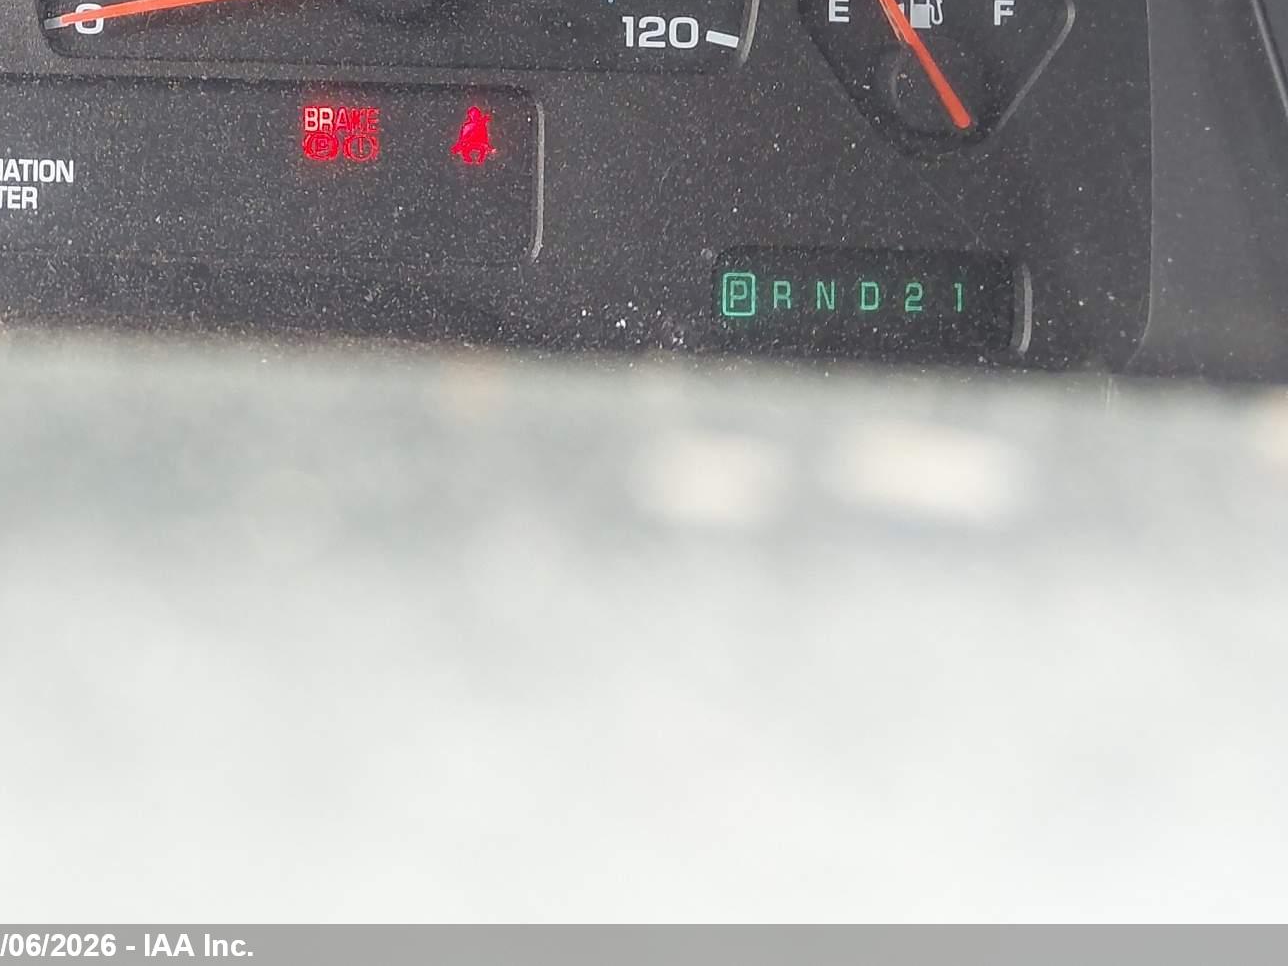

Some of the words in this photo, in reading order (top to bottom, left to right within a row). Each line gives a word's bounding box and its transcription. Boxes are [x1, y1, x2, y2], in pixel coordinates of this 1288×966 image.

[74, 3, 105, 34] 0
[994, 0, 1016, 26] F
[622, 16, 699, 49] 120
[304, 107, 379, 133] BRAKE
[730, 280, 749, 309] P
[773, 281, 792, 309] R
[817, 281, 836, 310] N
[861, 282, 879, 311] D
[905, 282, 924, 312] 2
[953, 282, 963, 313] 1
